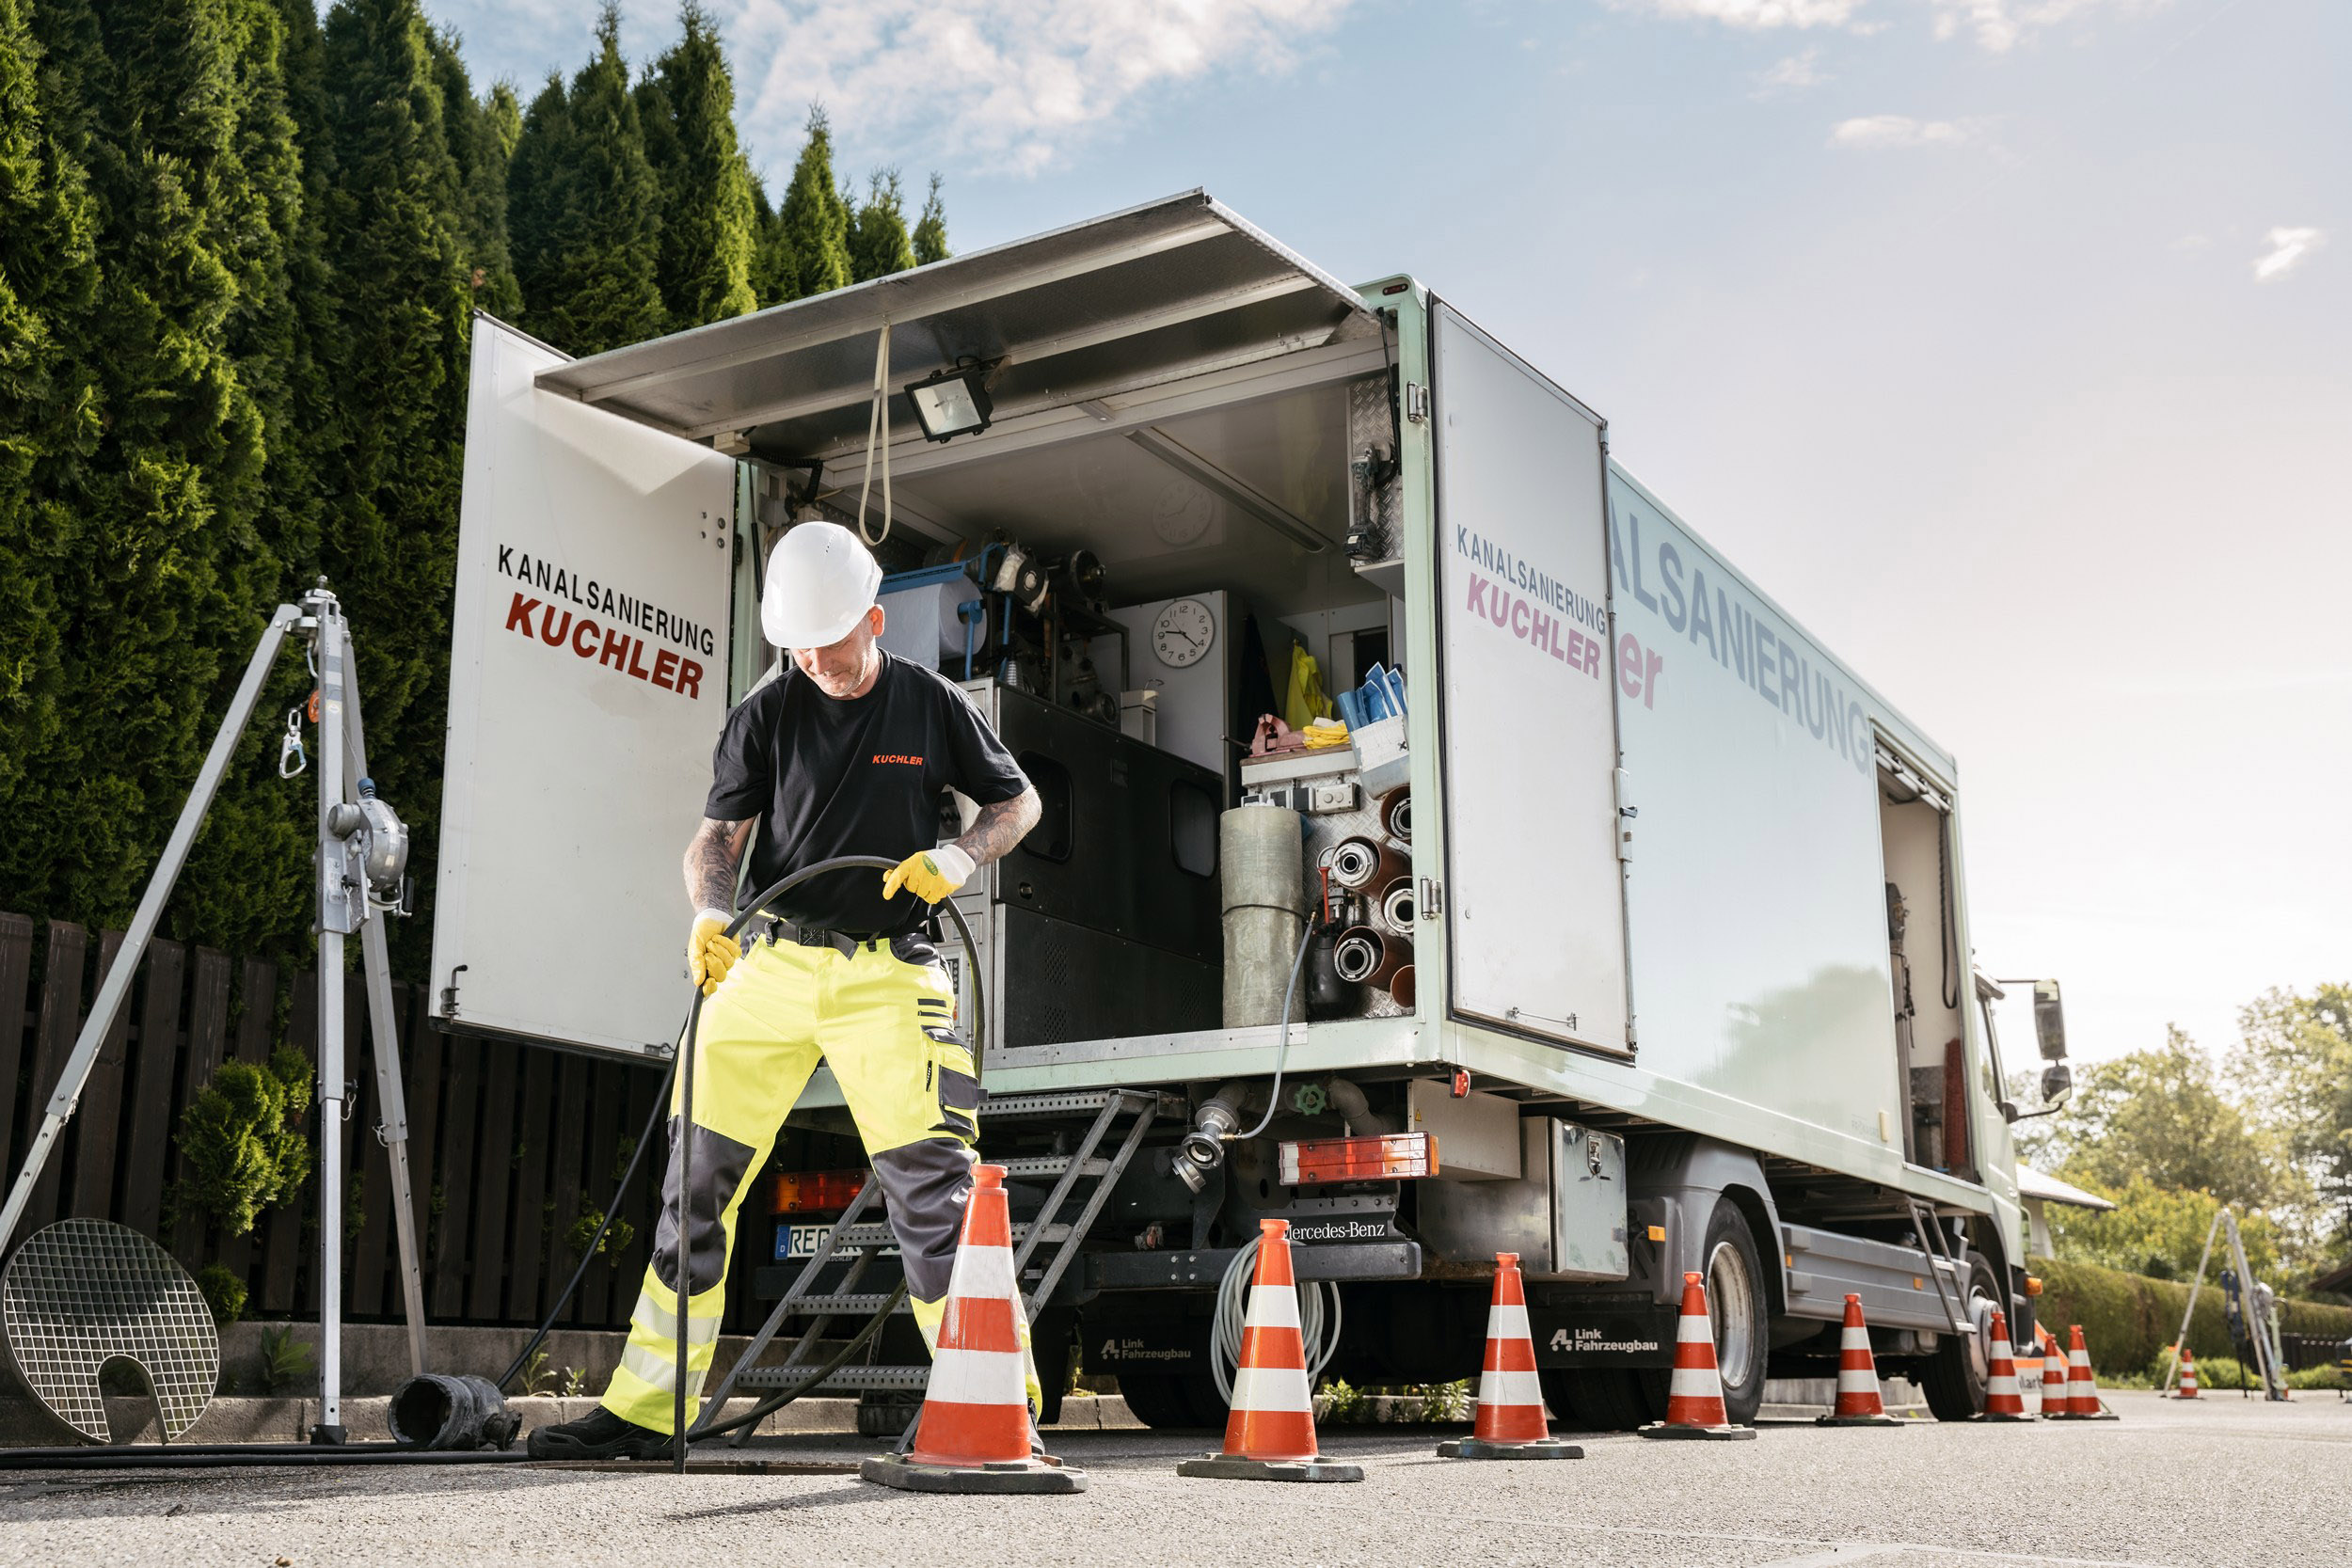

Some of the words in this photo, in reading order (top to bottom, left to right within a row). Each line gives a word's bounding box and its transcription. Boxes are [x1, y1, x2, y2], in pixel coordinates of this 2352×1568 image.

[1456, 523, 1606, 637] KANALSANIERUNG
[499, 544, 714, 657] KANALSANIERUNG
[1169, 610, 1176, 618] 11
[1201, 626, 1208, 635] 3
[1467, 572, 1600, 680] KUCHLER
[1157, 631, 1165, 640] 9
[505, 592, 705, 700] KUCHLER
[872, 754, 924, 766] KUCHLER
[779, 1244, 786, 1253] D
[1575, 1328, 1602, 1339] Link
[1121, 1339, 1145, 1349] Link
[1575, 1339, 1659, 1353] Fahrzeugbau
[1121, 1348, 1191, 1360] Fahrzeugbau
